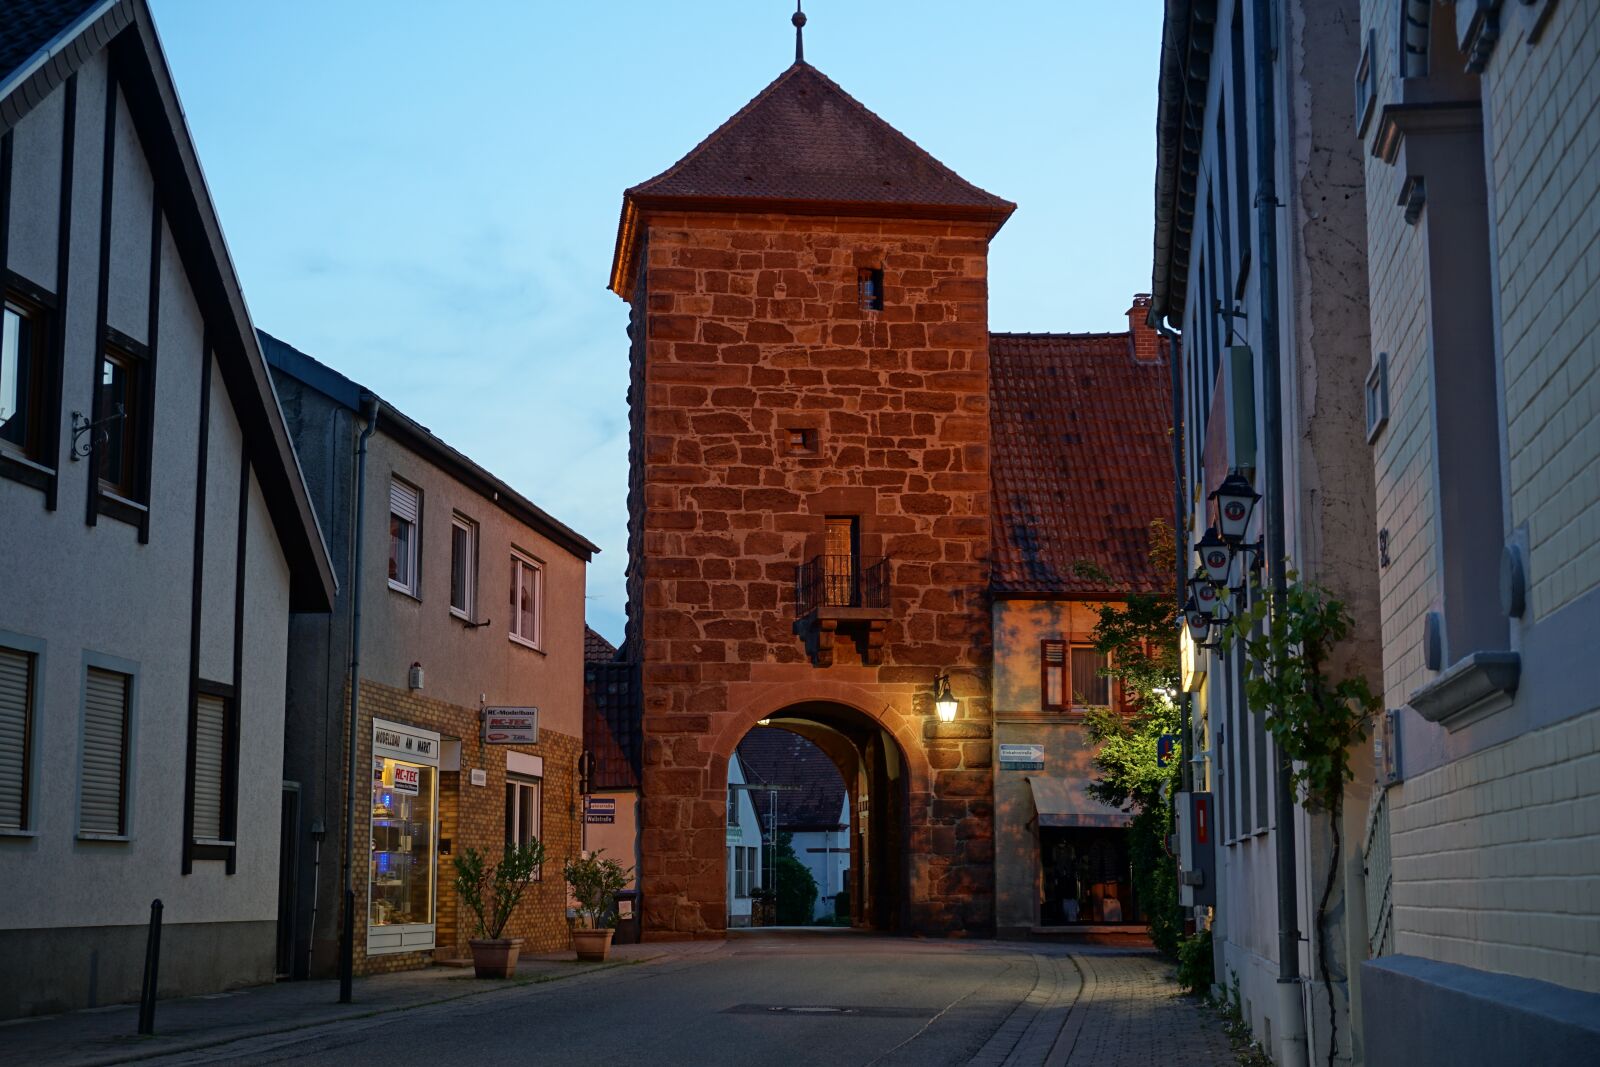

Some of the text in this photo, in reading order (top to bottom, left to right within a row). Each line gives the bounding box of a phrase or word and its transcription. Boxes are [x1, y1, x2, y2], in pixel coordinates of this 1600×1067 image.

[375, 730, 432, 754] MODELLBAU AM MARKT
[395, 767, 418, 782] RC-TEC
